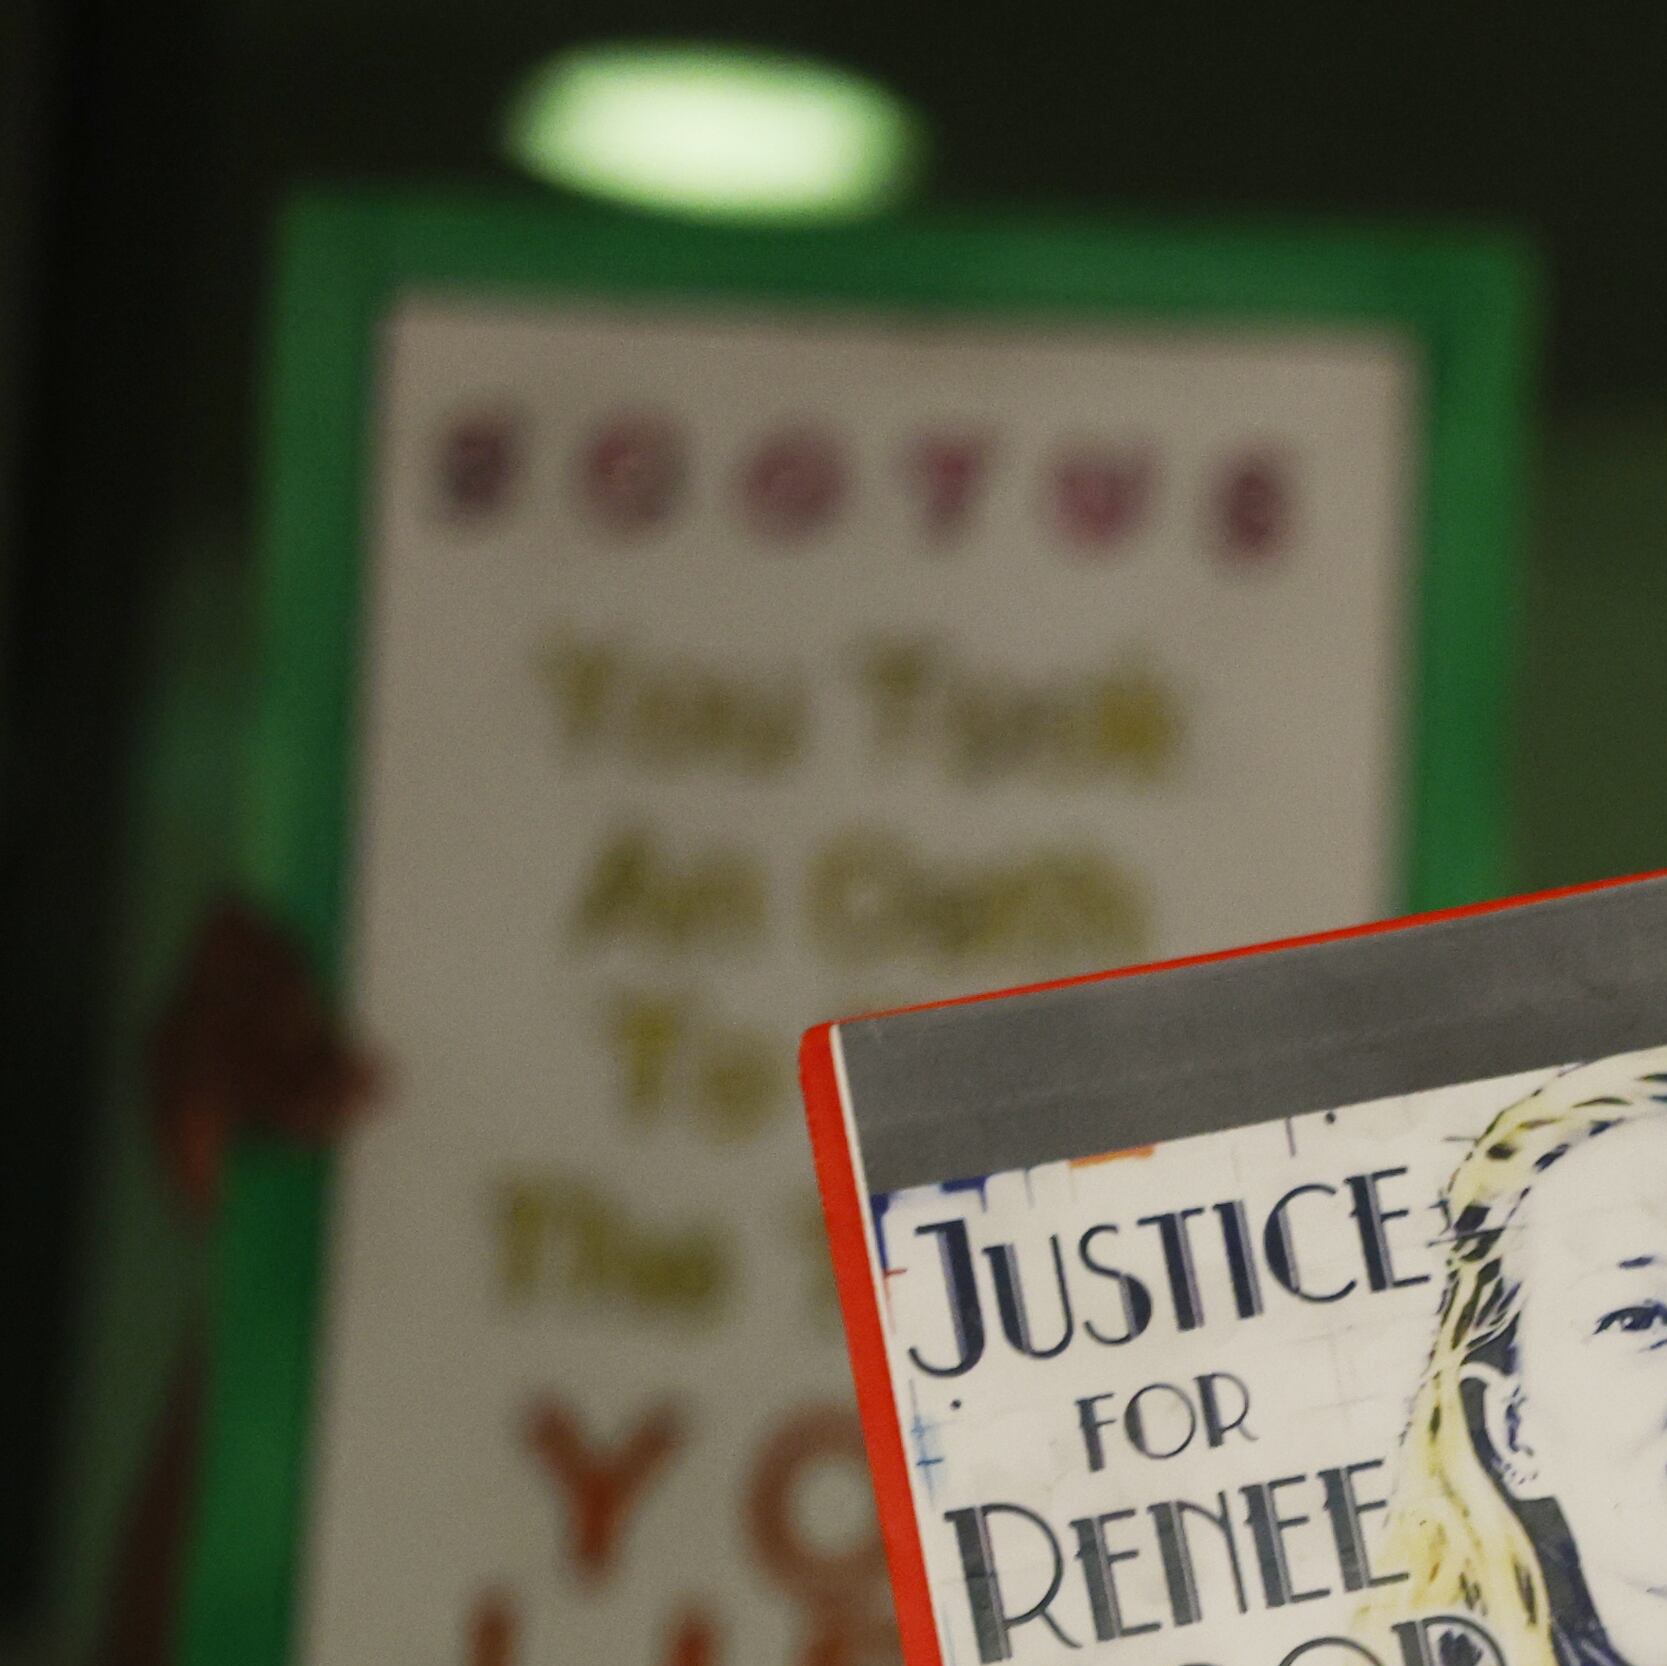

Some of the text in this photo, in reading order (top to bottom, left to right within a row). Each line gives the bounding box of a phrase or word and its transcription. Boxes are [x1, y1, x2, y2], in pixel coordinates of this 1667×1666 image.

[909, 1167, 1430, 1378] JUSTICE
[522, 1390, 884, 1598] YO
[1074, 1372, 1259, 1473] FOR
[943, 1458, 1410, 1665] RENEE
